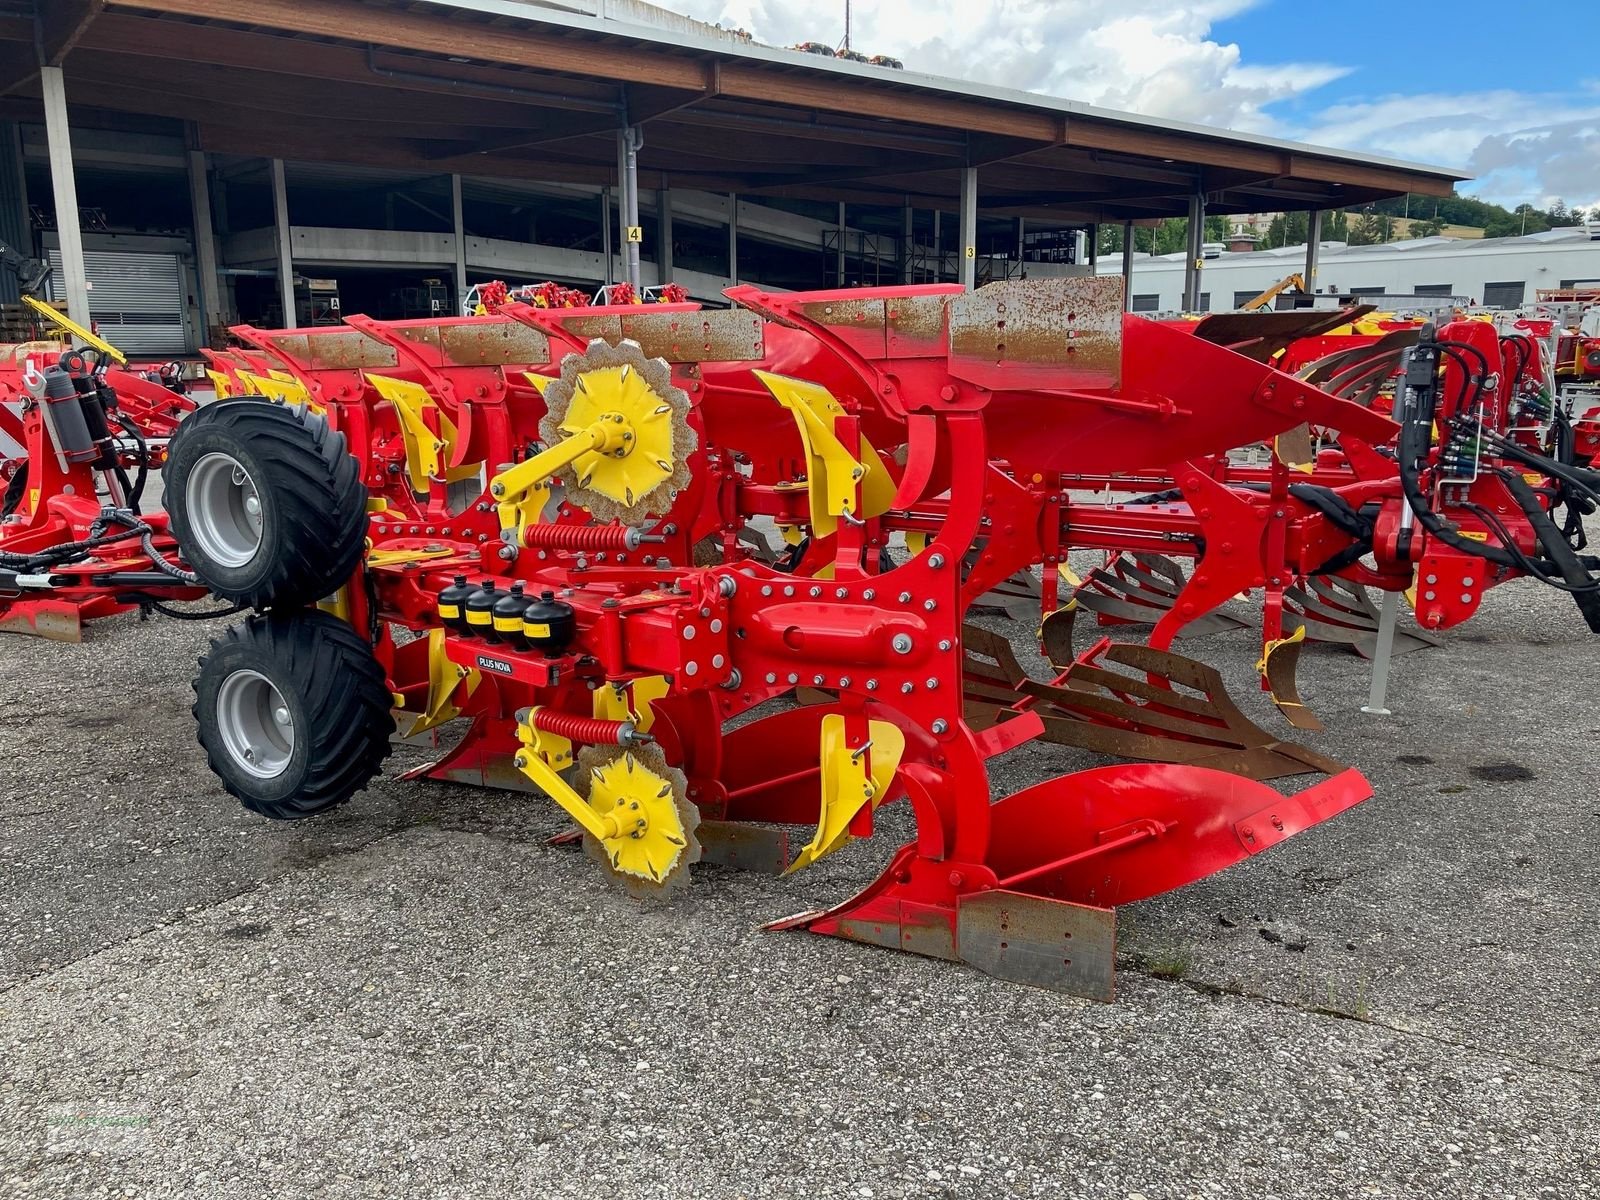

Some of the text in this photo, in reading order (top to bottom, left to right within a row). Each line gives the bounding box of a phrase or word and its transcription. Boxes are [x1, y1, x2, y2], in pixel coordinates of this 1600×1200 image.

[631, 227, 638, 240] 4
[968, 247, 973, 257] 3
[1198, 260, 1203, 269] 2
[332, 298, 338, 308] A
[433, 300, 438, 309] A
[479, 657, 511, 673] PLUS NOVA
